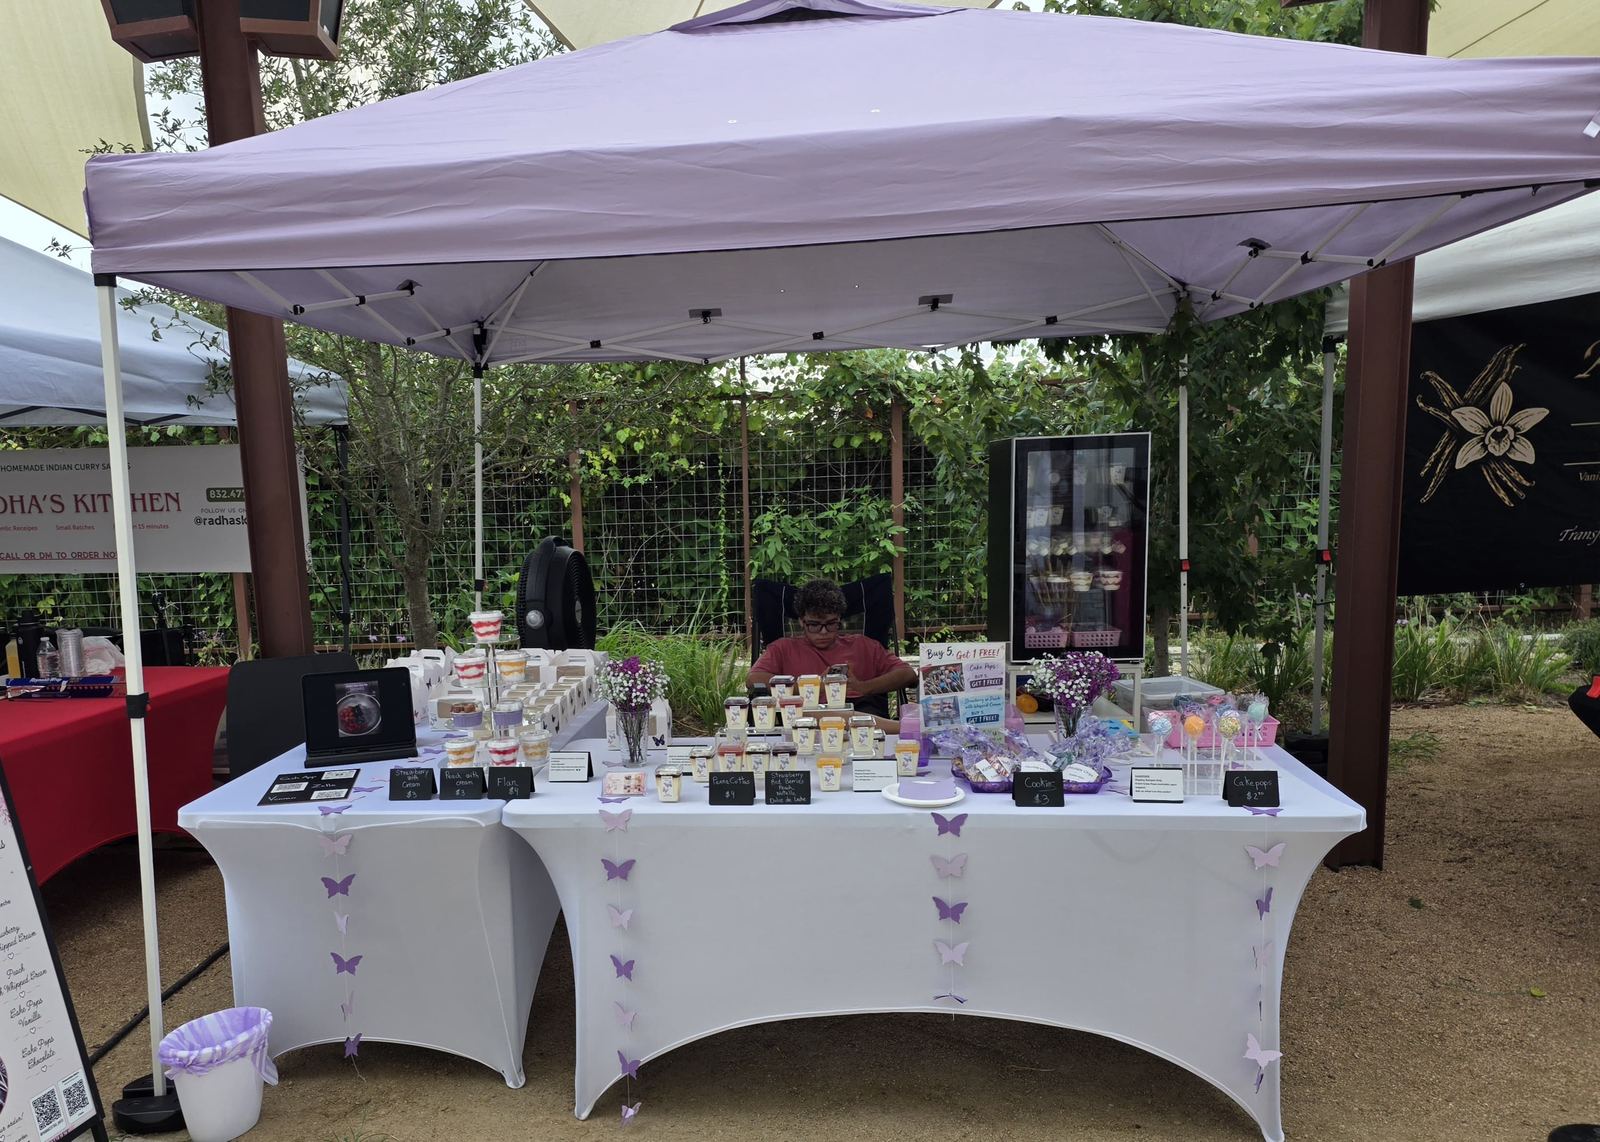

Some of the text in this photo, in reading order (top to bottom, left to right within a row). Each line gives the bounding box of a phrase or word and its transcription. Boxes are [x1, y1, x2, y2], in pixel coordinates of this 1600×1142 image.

[74, 463, 100, 471] CURRY
[73, 492, 182, 513] KITHEN
[39, 552, 52, 560] DM
[71, 551, 99, 559] ORDER
[927, 648, 944, 660] Buy
[979, 648, 1000, 657] FREE!
[497, 777, 519, 787] Flan
